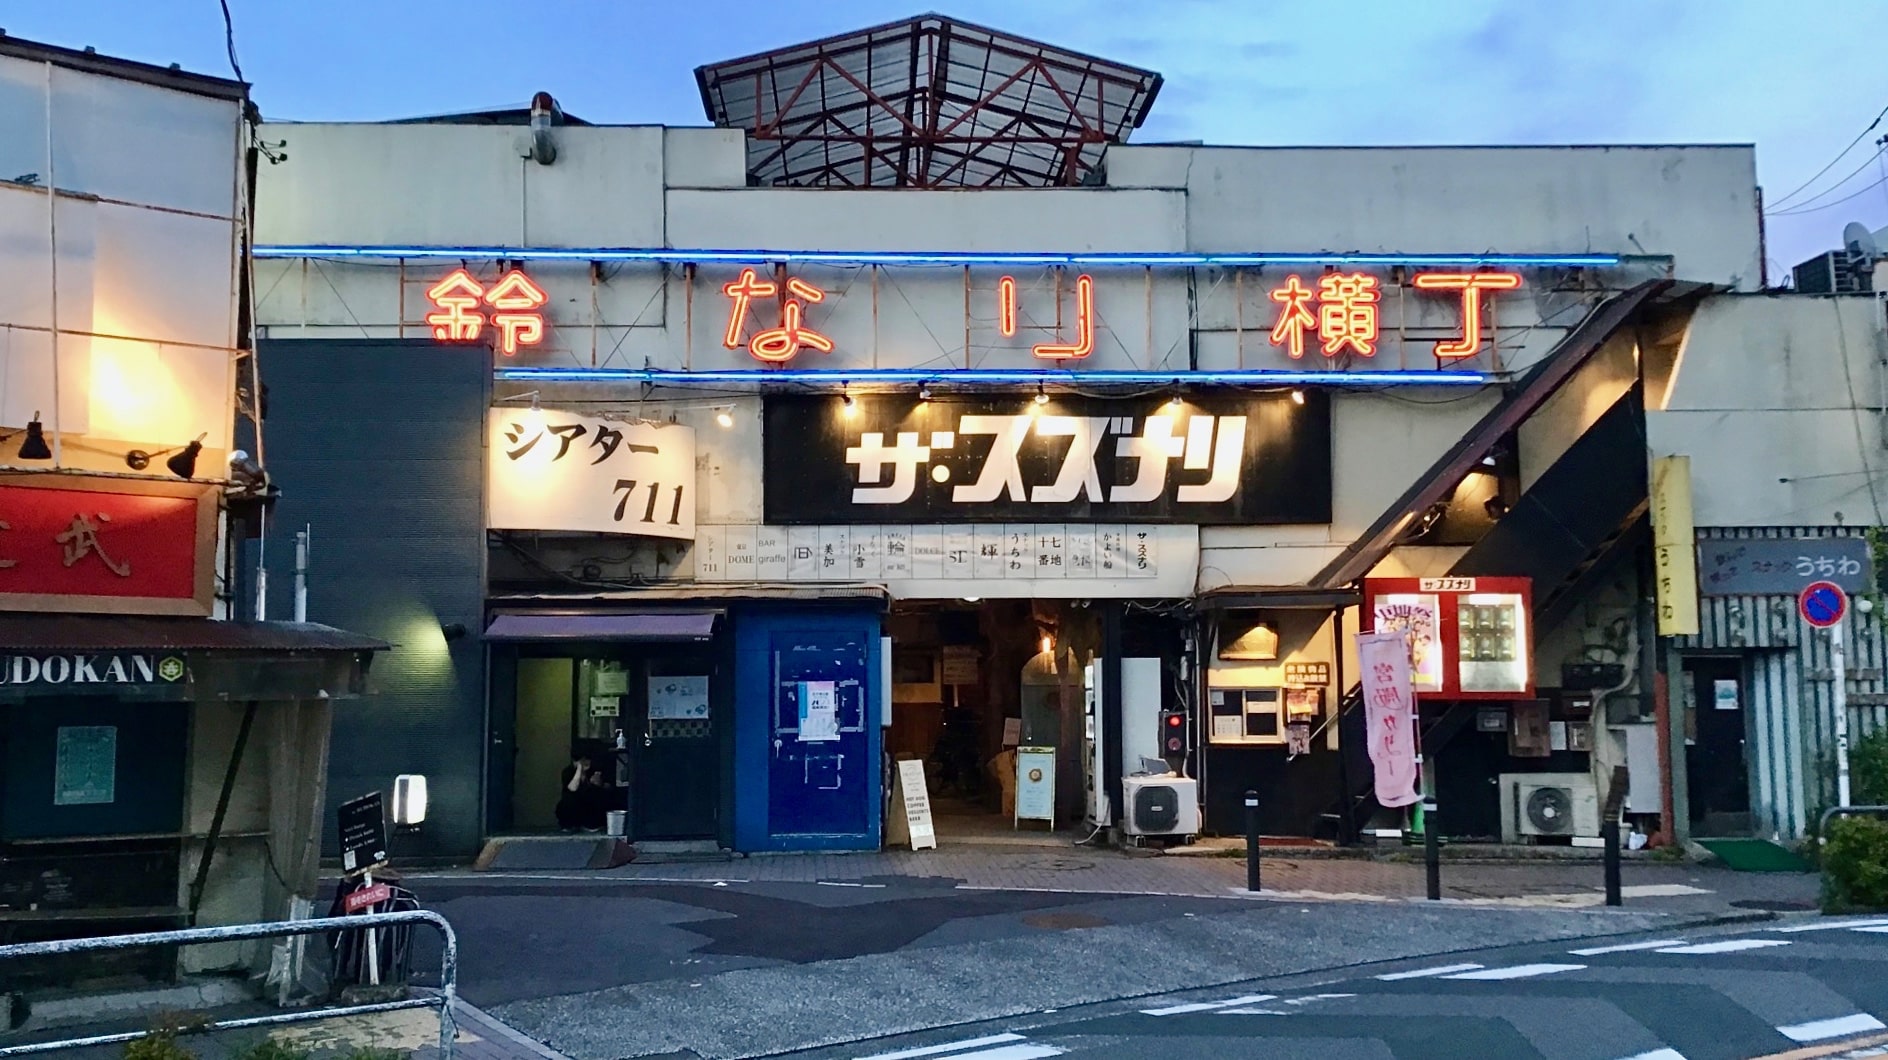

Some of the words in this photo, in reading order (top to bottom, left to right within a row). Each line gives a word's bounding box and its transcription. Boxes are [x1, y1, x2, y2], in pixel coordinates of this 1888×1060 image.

[427, 268, 1523, 361] 鈴なり横丁
[504, 423, 659, 466] シアター
[612, 479, 684, 525] 711
[728, 555, 754, 564] DOME
[758, 555, 786, 565] giraffe
[823, 543, 835, 568] 美加
[1010, 532, 1021, 570] うちわ
[703, 563, 717, 572] 711
[1796, 555, 1861, 577] うちわ
